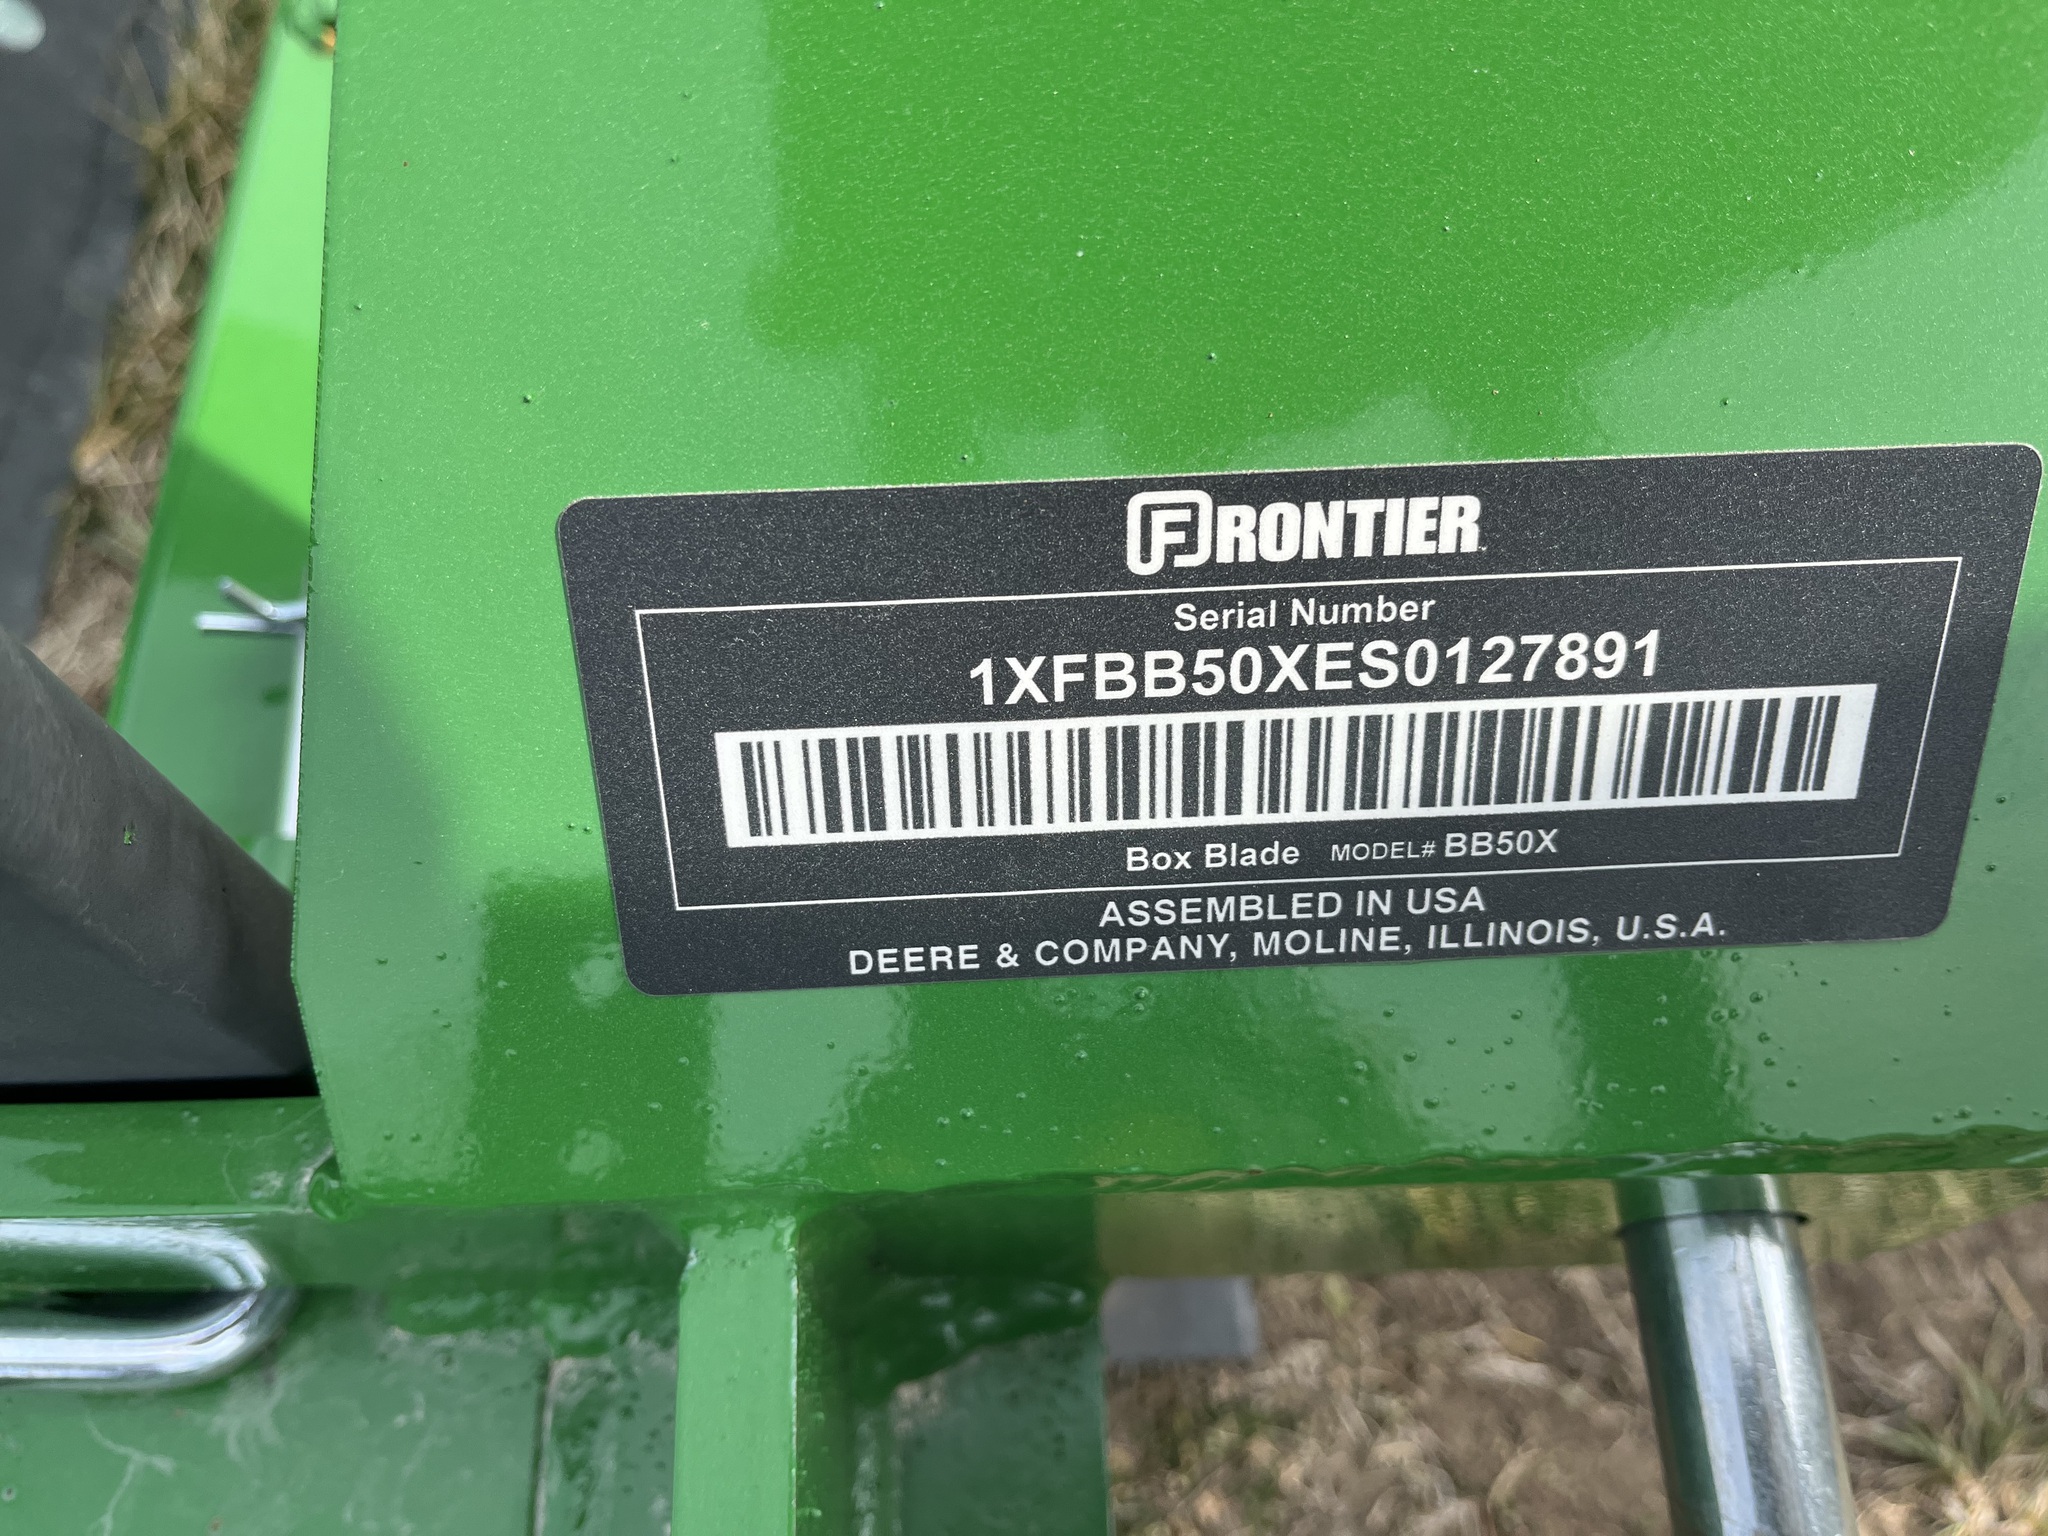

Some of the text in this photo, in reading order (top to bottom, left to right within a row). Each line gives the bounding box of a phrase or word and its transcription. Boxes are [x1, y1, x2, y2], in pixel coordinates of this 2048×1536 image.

[1125, 490, 1483, 576] FRONTIER
[1173, 595, 1437, 633] Serial Number
[970, 628, 1660, 706] 1XFBB50XES0127891
[1126, 828, 1559, 872] Box Blade MODEL# BB50X
[1099, 886, 1486, 927] ASSEMBLED IN USA
[849, 912, 1728, 975] DEERE & COMPANY, MOLINE, ILLINOIS, U.S.A.
